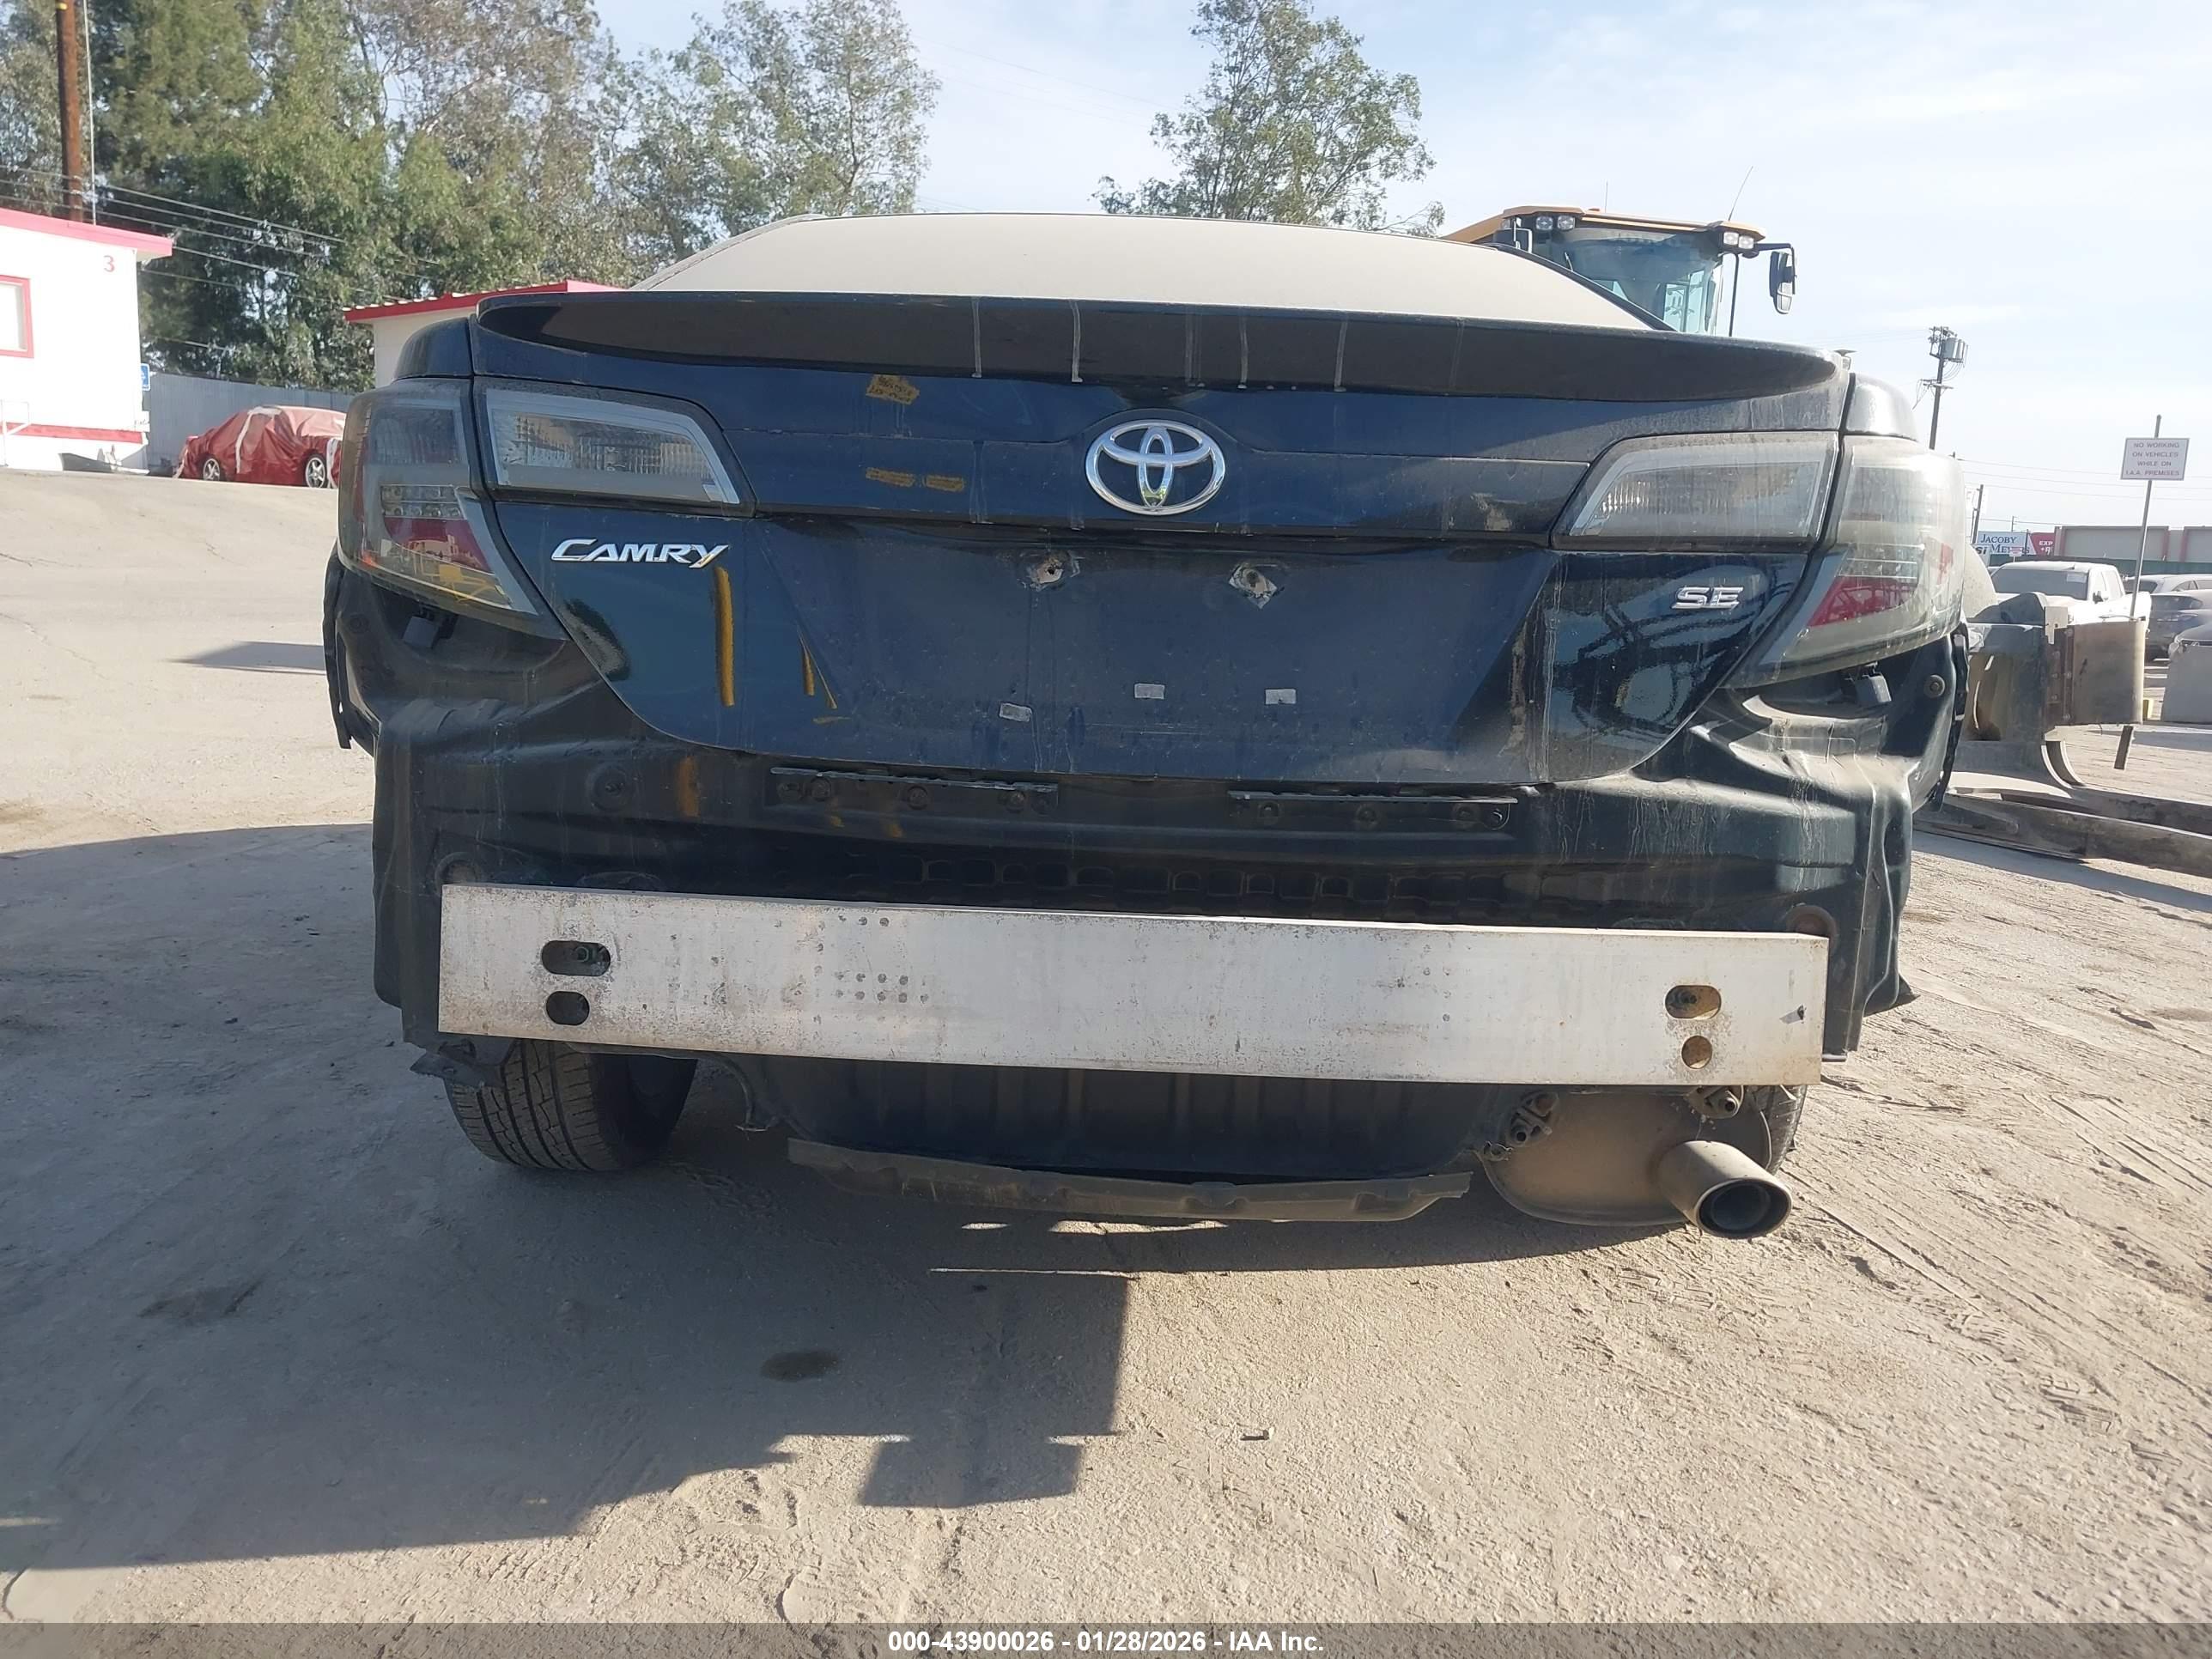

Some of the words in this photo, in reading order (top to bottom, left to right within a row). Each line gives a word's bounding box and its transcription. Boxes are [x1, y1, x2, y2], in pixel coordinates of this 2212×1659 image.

[103, 255, 115, 272] 3
[1981, 534, 2017, 543] JACOBY
[551, 538, 728, 568] CAMRY
[1671, 586, 1744, 610] SE
